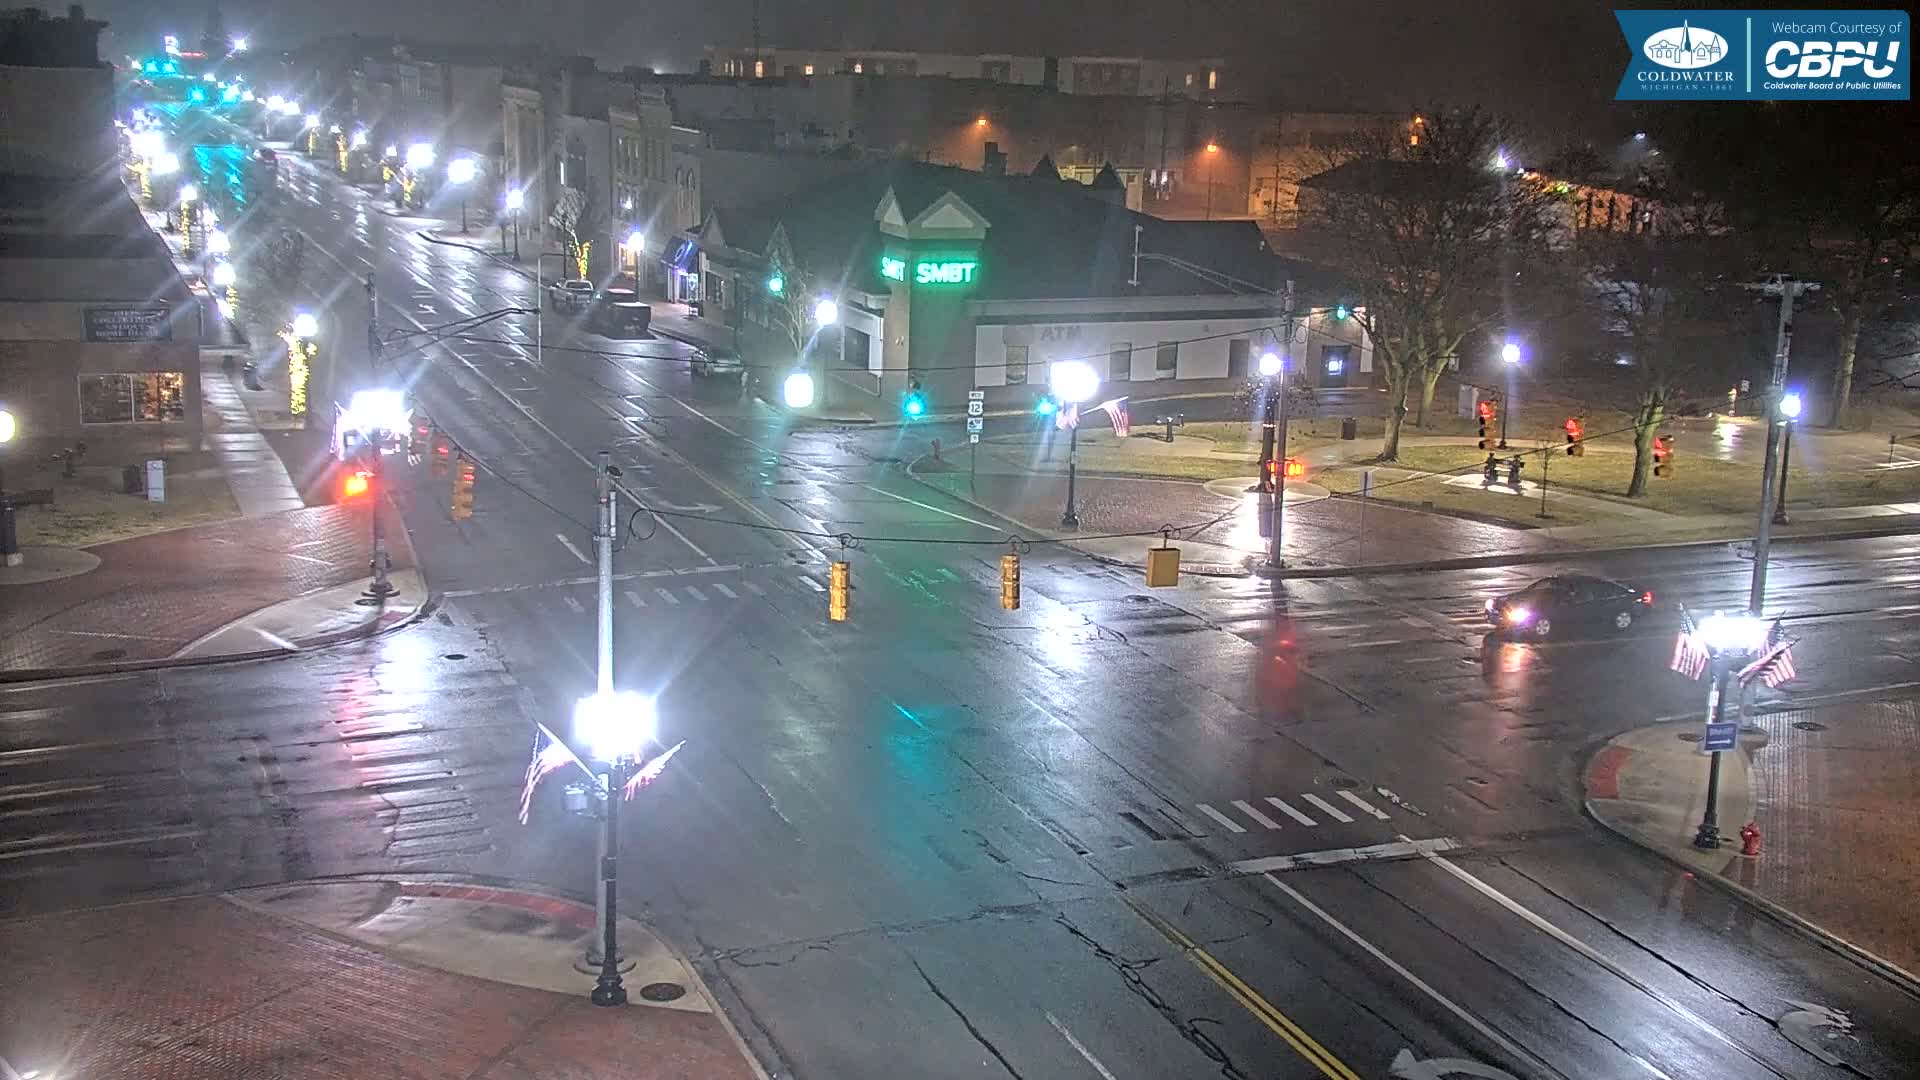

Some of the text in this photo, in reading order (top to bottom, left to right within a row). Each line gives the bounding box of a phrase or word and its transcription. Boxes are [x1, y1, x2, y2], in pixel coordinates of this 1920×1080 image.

[916, 262, 976, 284] SMBT
[1040, 326, 1080, 341] ATM
[971, 403, 981, 413] 12
